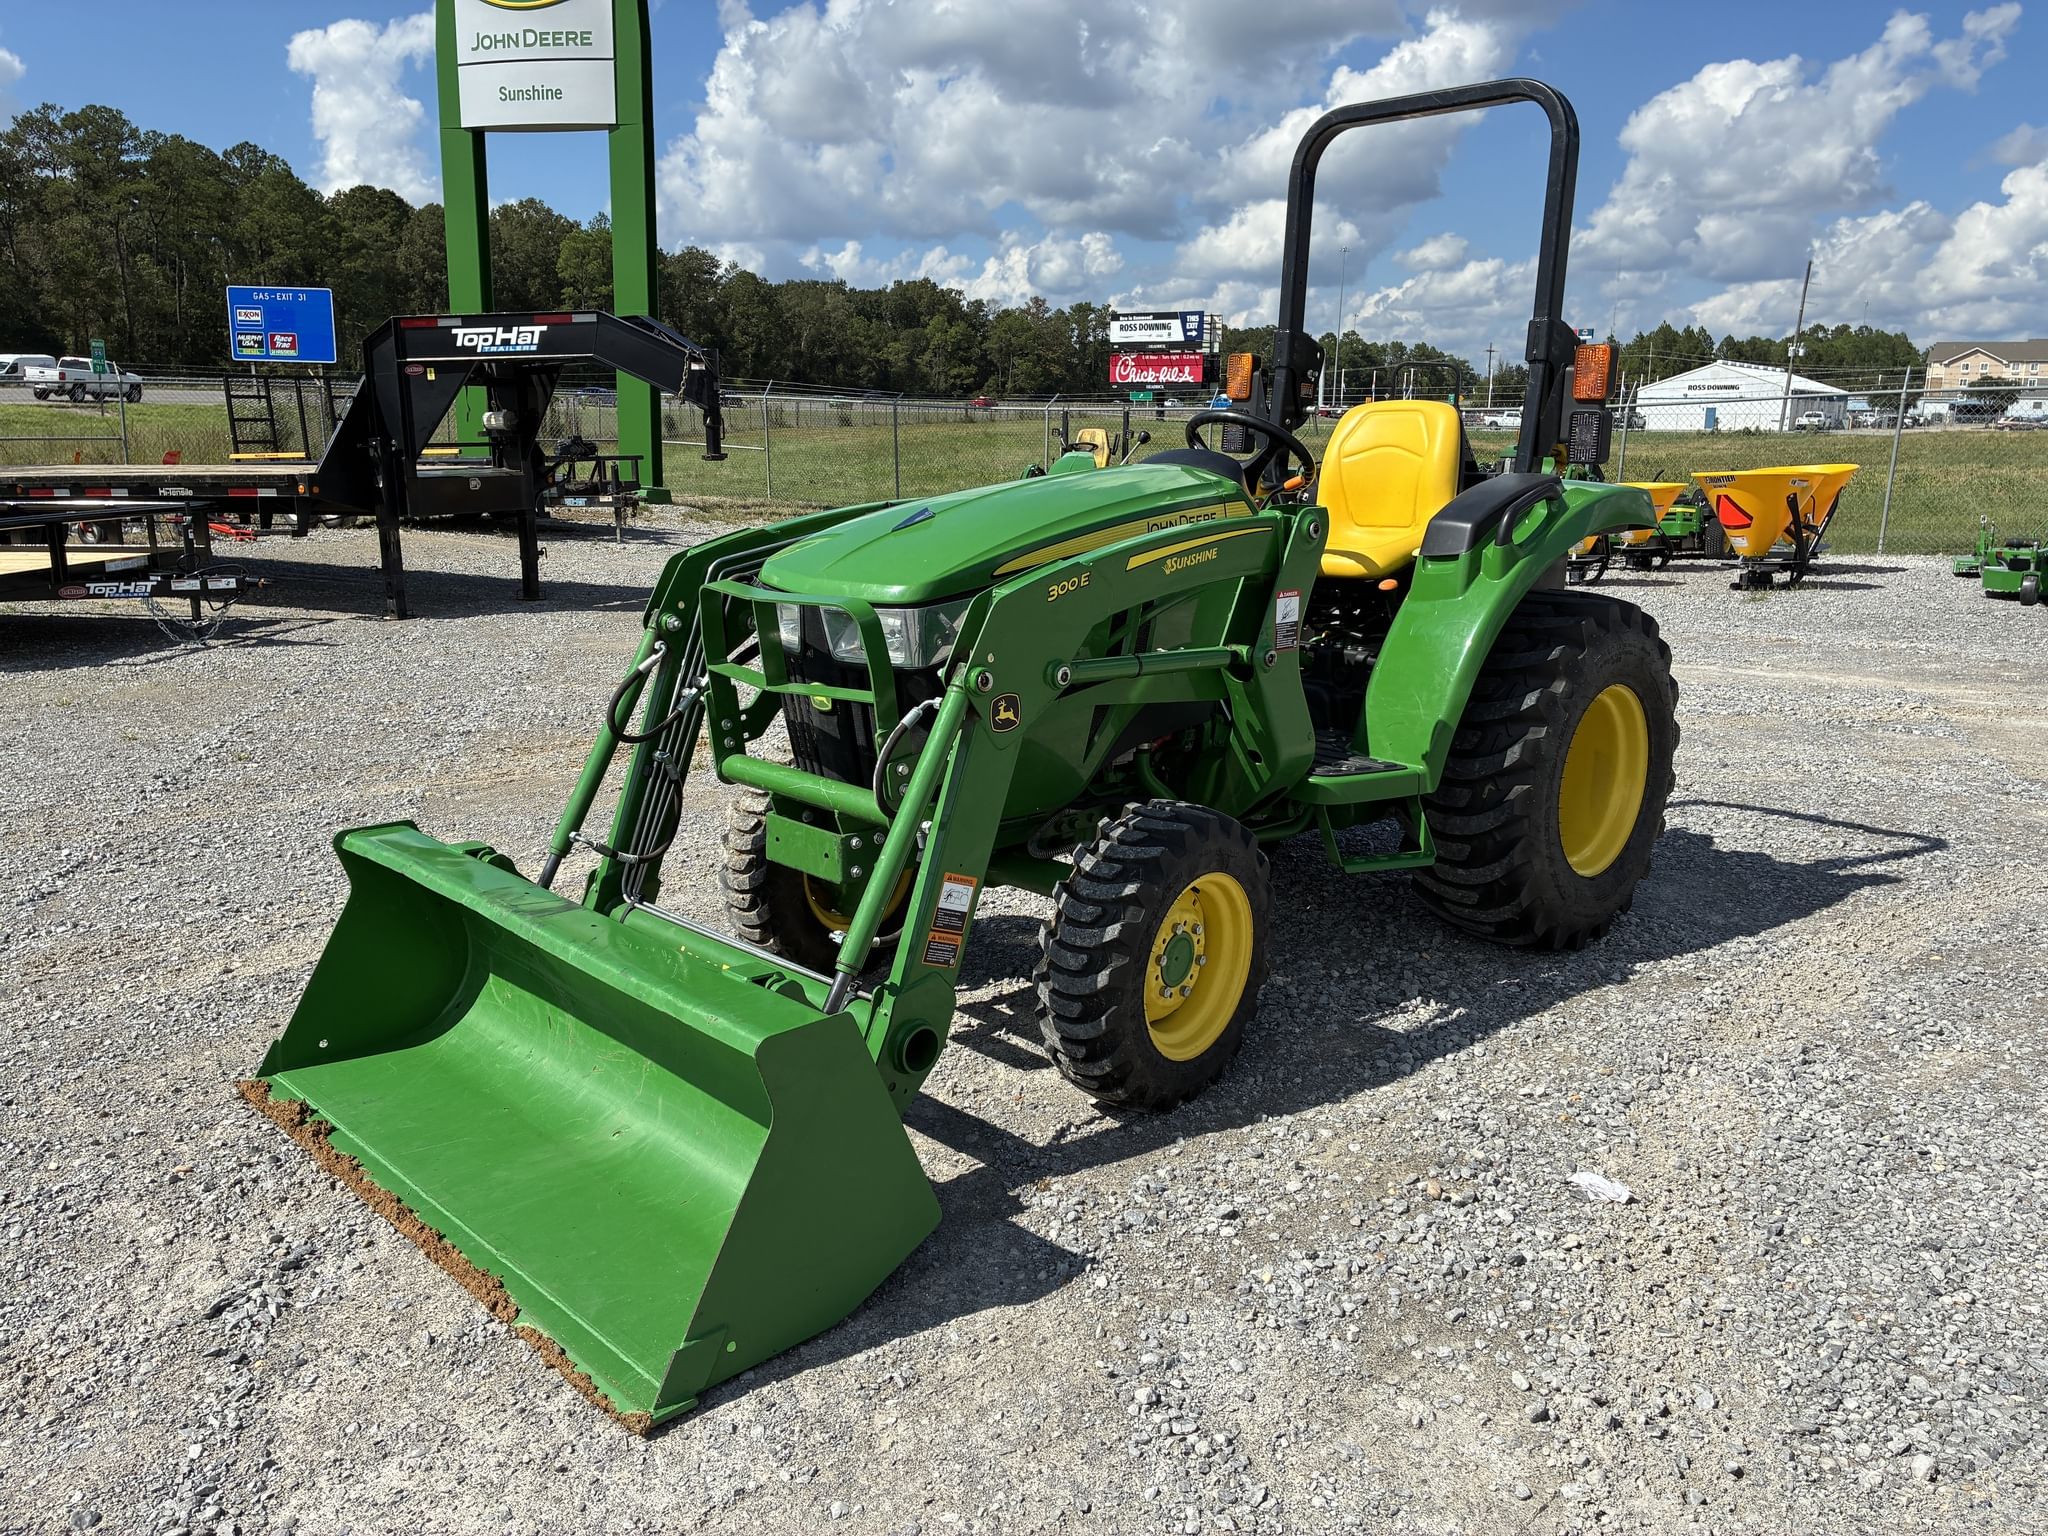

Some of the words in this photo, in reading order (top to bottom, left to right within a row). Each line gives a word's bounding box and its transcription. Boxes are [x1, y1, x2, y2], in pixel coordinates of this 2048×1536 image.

[471, 32, 520, 51] JOHN
[522, 28, 593, 48] DEERE
[499, 84, 563, 102] Sunshine
[298, 293, 307, 301] 31
[1186, 314, 1200, 322] THIS
[1119, 323, 1138, 332] ROSS
[1138, 322, 1172, 331] DOWNING
[1186, 322, 1199, 330] EXIT
[238, 334, 263, 342] MURPHY
[274, 334, 293, 343] Race
[275, 341, 291, 349] Trac
[1706, 383, 1740, 391] DOWNING
[1169, 547, 1218, 572] SUNSHINE
[953, 875, 974, 885] WARNING
[937, 935, 959, 944] WARNING
